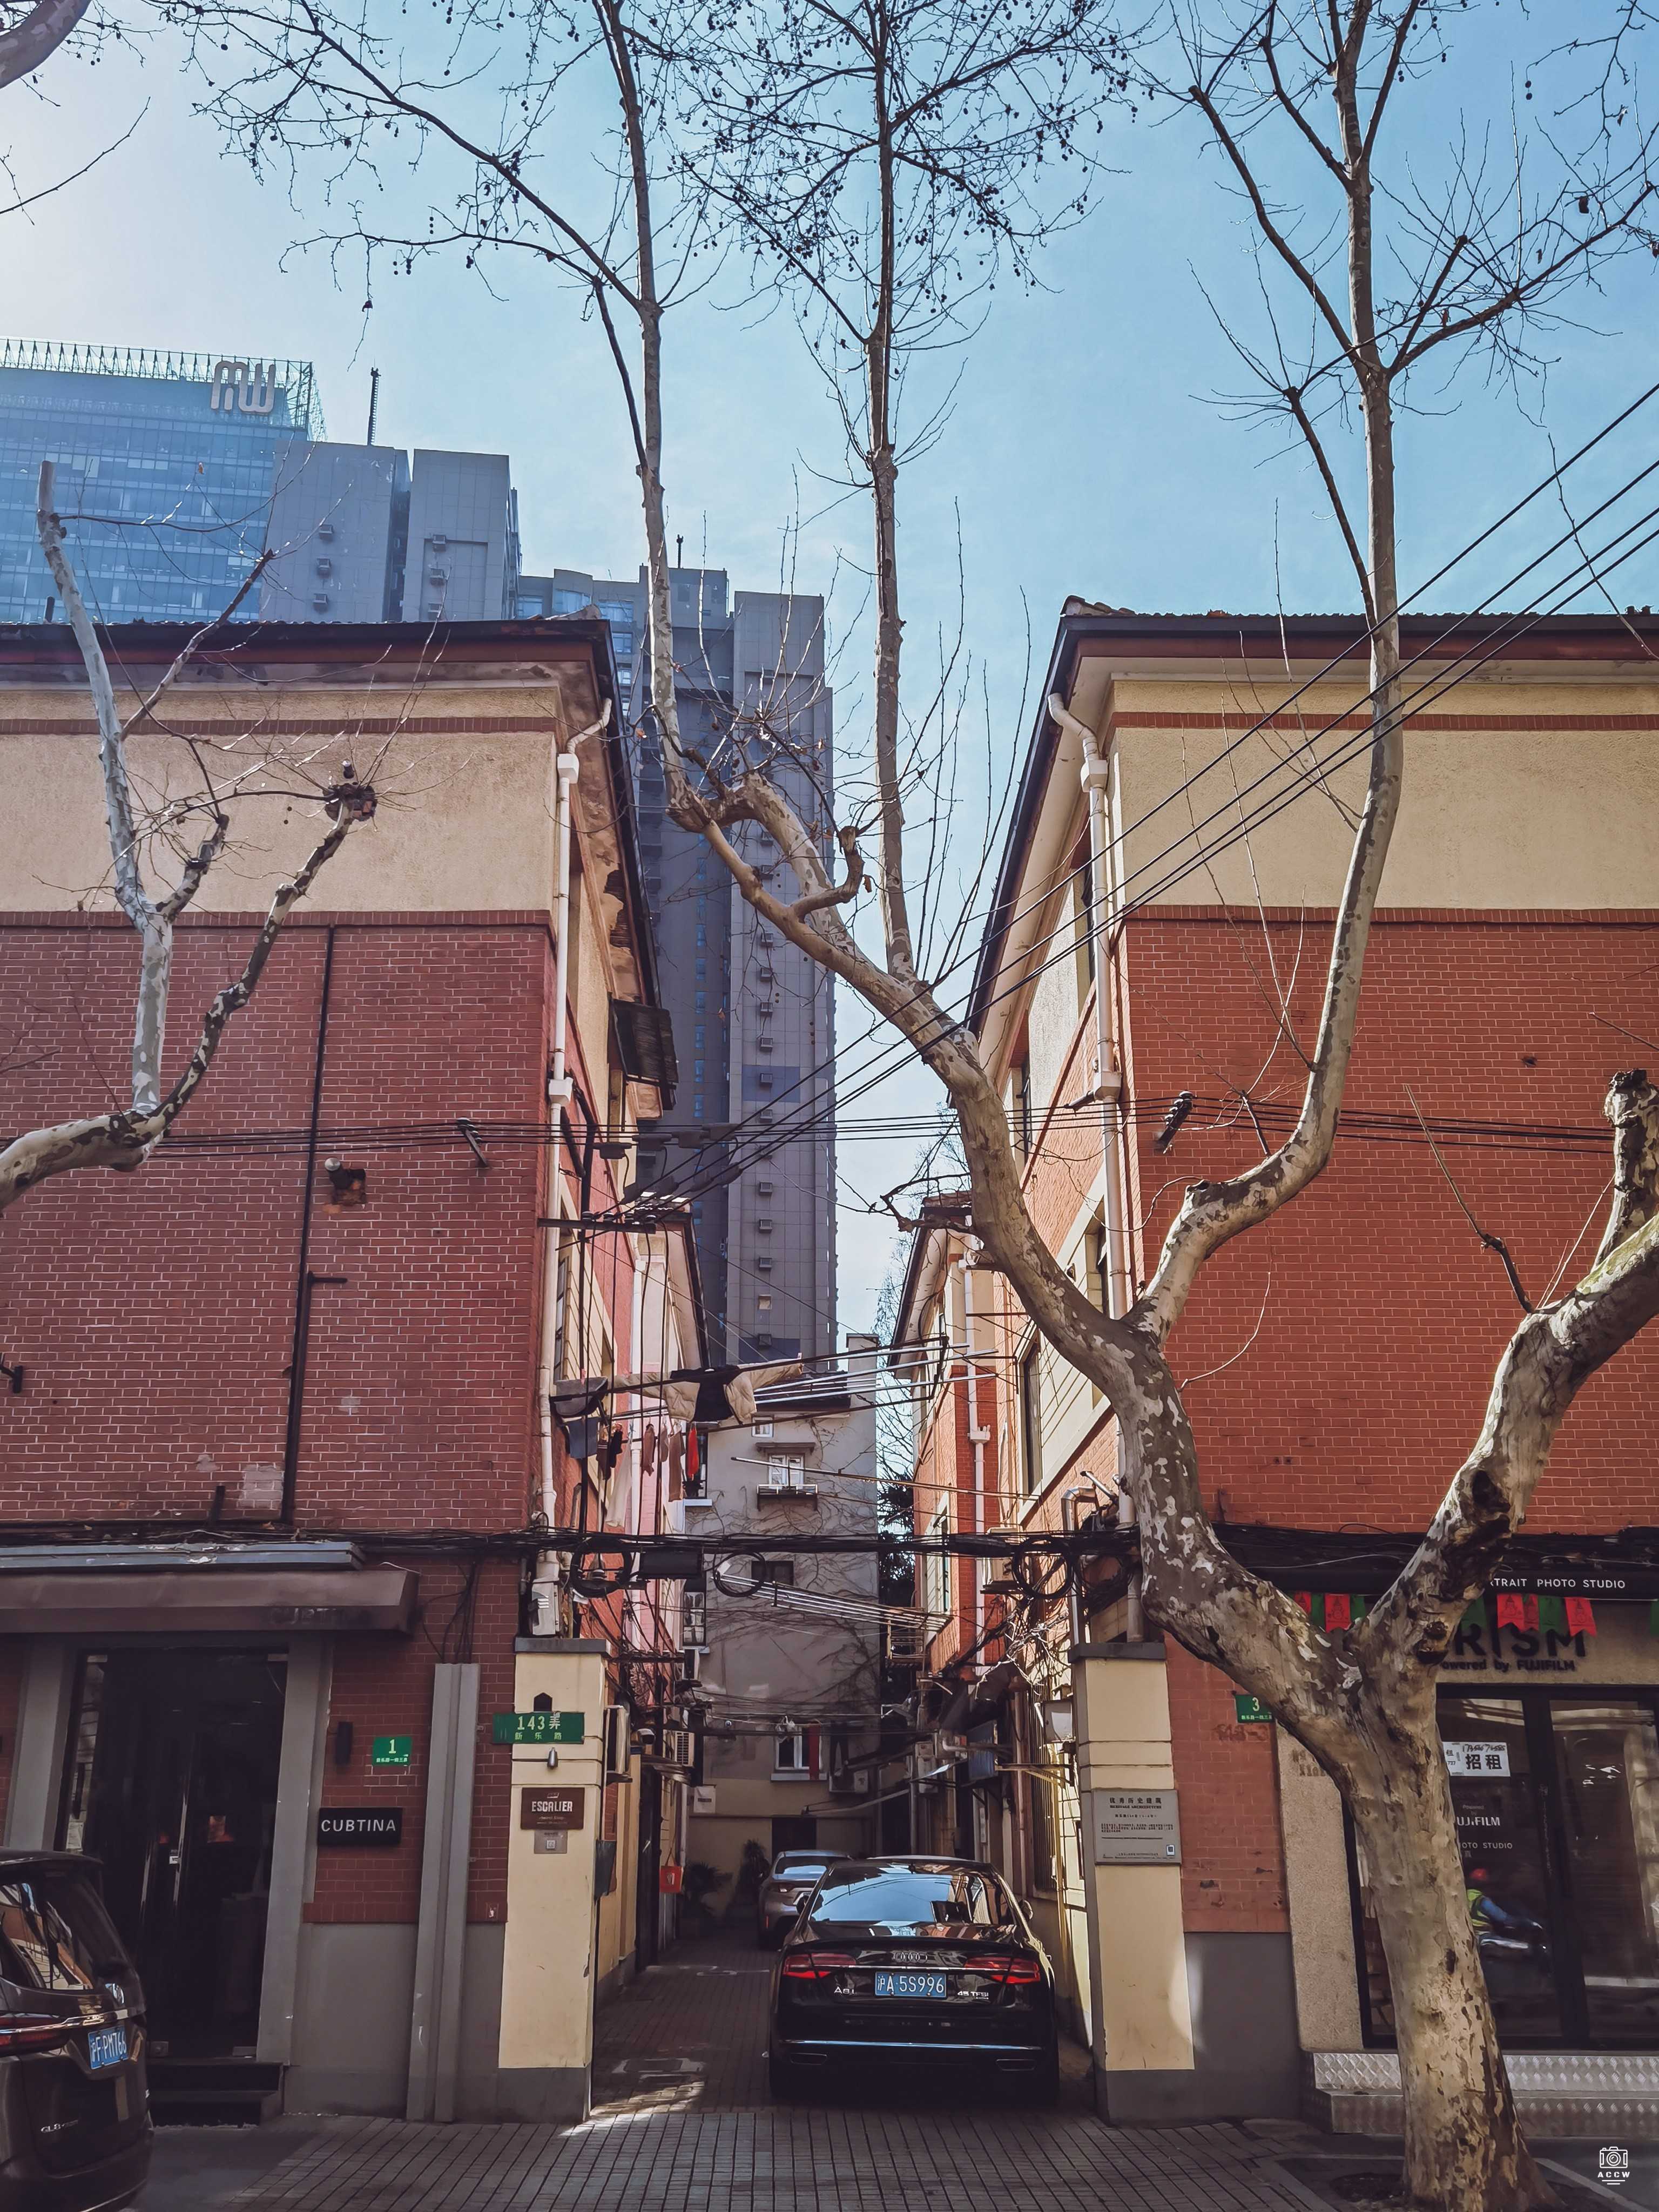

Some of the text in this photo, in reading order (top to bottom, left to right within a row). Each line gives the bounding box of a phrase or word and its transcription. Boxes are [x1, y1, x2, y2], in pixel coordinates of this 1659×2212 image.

[1491, 1578, 1625, 1588] TRAIT PHOTO STUDIO
[1454, 1619, 1587, 1657] RISM
[1441, 1659, 1575, 1673] owered by FUJIFILM
[1252, 1697, 1260, 1711] 3
[515, 1732, 562, 1741] 新乐路
[388, 1739, 396, 1754] 1
[1465, 1754, 1502, 1770] 招租
[321, 1819, 396, 1832] CUBTINA
